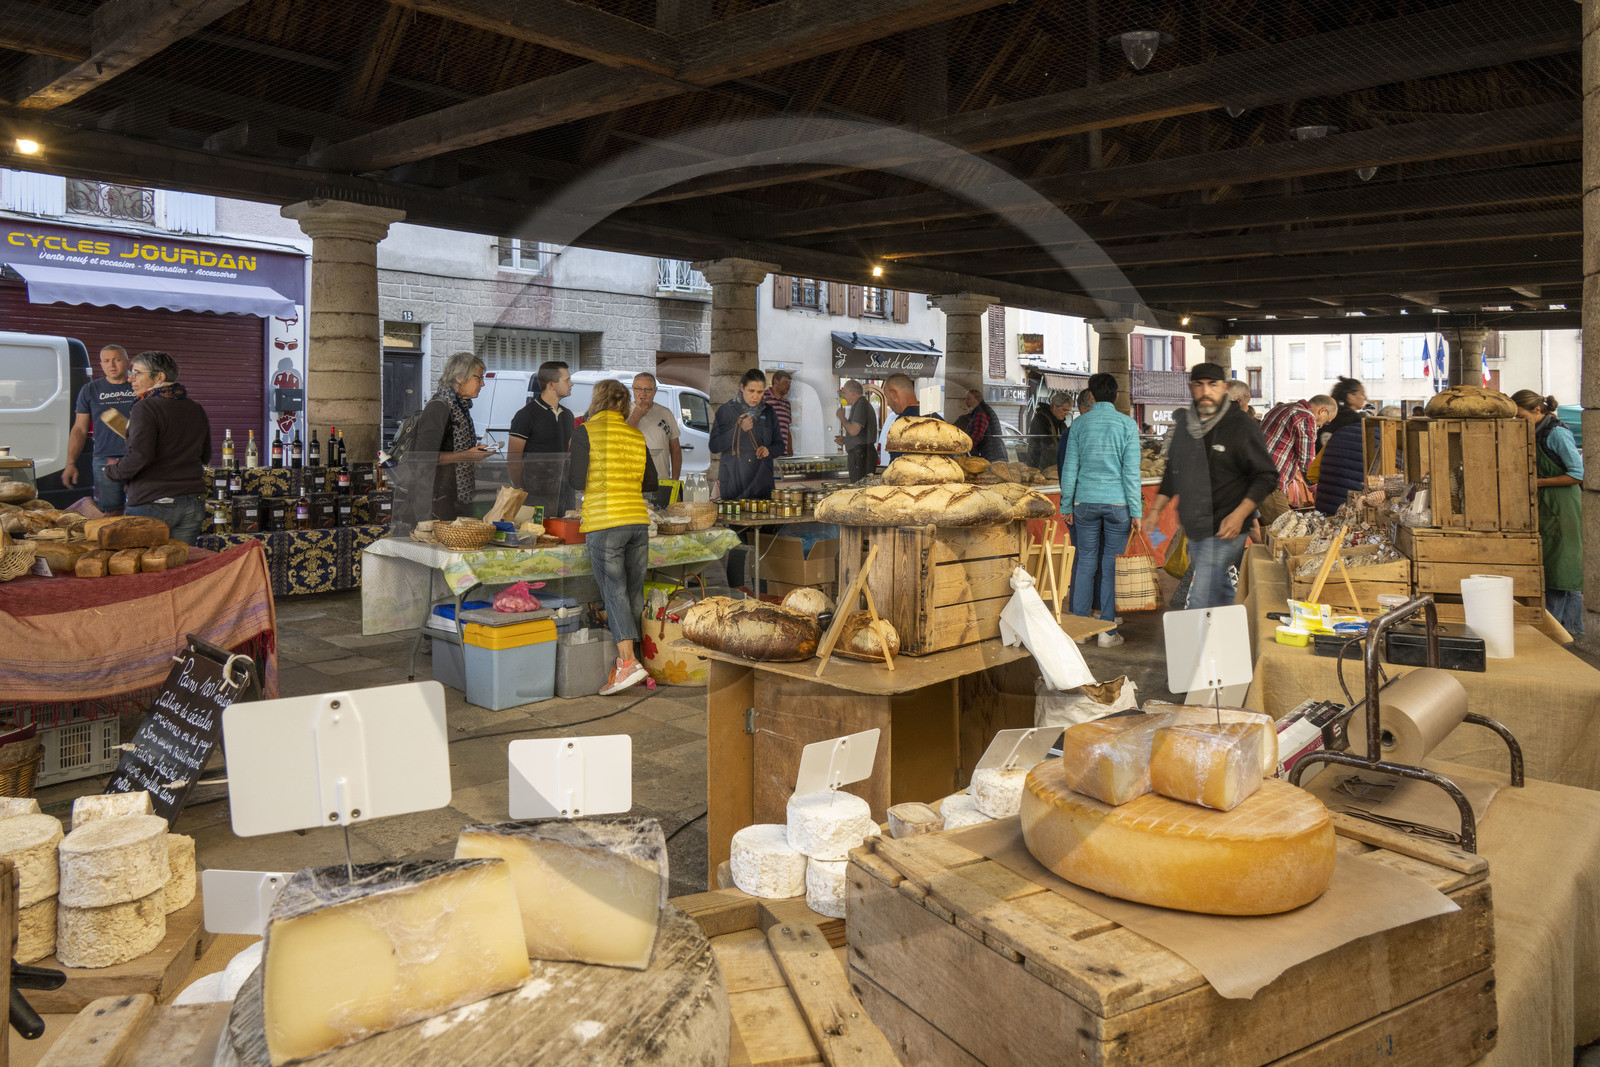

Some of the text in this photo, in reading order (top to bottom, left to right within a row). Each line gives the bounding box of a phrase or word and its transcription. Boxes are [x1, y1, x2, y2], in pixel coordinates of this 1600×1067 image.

[8, 232, 256, 271] CYCLES JOURDAN
[39, 247, 237, 279] Vente neuf et occasion Réparation Accessoires
[403, 311, 413, 321] 13
[890, 353, 899, 368] de
[901, 354, 924, 370] Cacao
[177, 658, 198, 693] Pains
[160, 690, 181, 714] Culture
[180, 702, 190, 718] de
[143, 724, 157, 743] Sans
[152, 712, 181, 737] anciennes
[160, 788, 176, 806] dans
